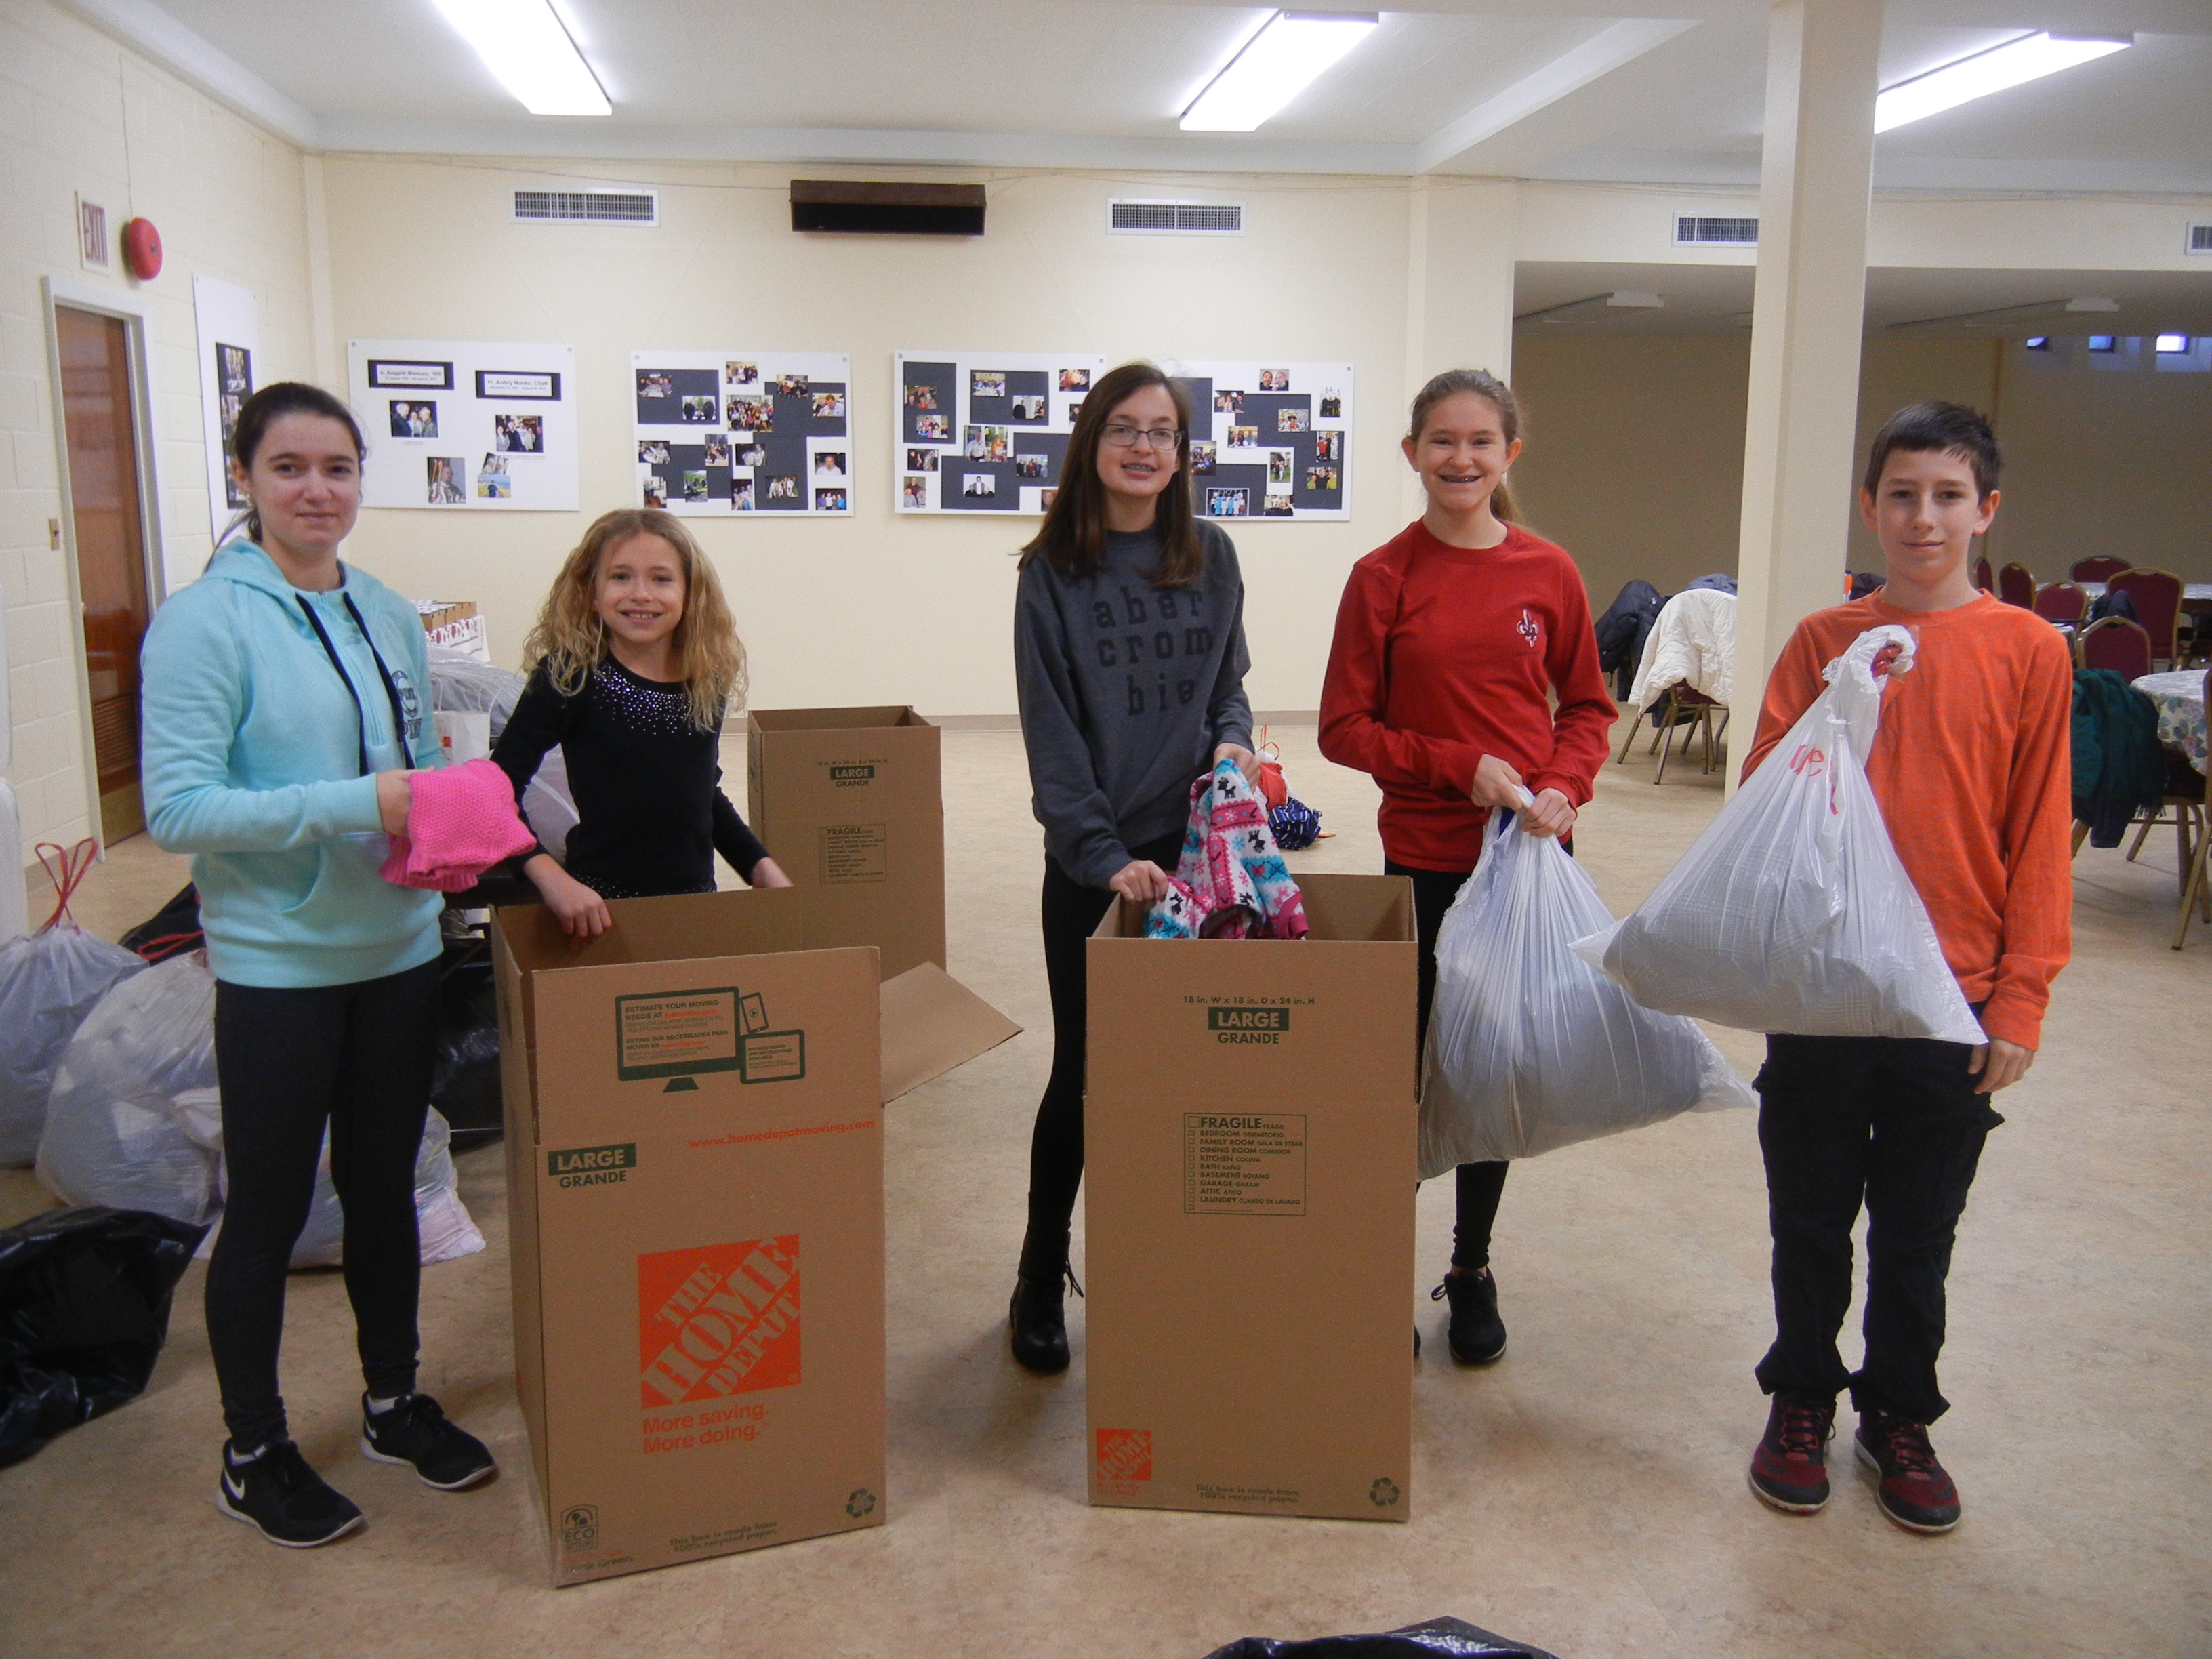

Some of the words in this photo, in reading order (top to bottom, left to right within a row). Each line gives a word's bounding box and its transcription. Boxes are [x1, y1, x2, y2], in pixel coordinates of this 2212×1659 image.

[1092, 585, 1203, 628] aber
[1097, 626, 1214, 667] crom
[1127, 672, 1195, 716] bie
[836, 768, 869, 778] LARGE
[836, 779, 870, 787] GRANDE
[625, 1004, 663, 1013] ESTIMATE
[689, 1000, 719, 1008] MOVING
[626, 1012, 651, 1021] NEEDS
[1218, 1012, 1279, 1028] LARGE
[1218, 1032, 1279, 1044] GRANDE
[1200, 1117, 1262, 1129] FRAGILE
[689, 1120, 876, 1149] www.homedepotmoving.com
[557, 1149, 625, 1172] LARGE
[559, 1171, 627, 1189] GRANDE
[655, 1262, 723, 1328] THE
[640, 1236, 800, 1403] HOME
[705, 1290, 800, 1395] DEPOT
[644, 1414, 695, 1435] More
[699, 1403, 769, 1426] saving.
[644, 1434, 695, 1454] More
[699, 1425, 761, 1446] doing.
[1096, 1431, 1151, 1479] HOME
[1200, 1492, 1226, 1500] 100%
[1229, 1494, 1266, 1502] recycled
[1248, 1486, 1274, 1494] made
[1277, 1488, 1300, 1496] from
[565, 1528, 595, 1541] ECO
